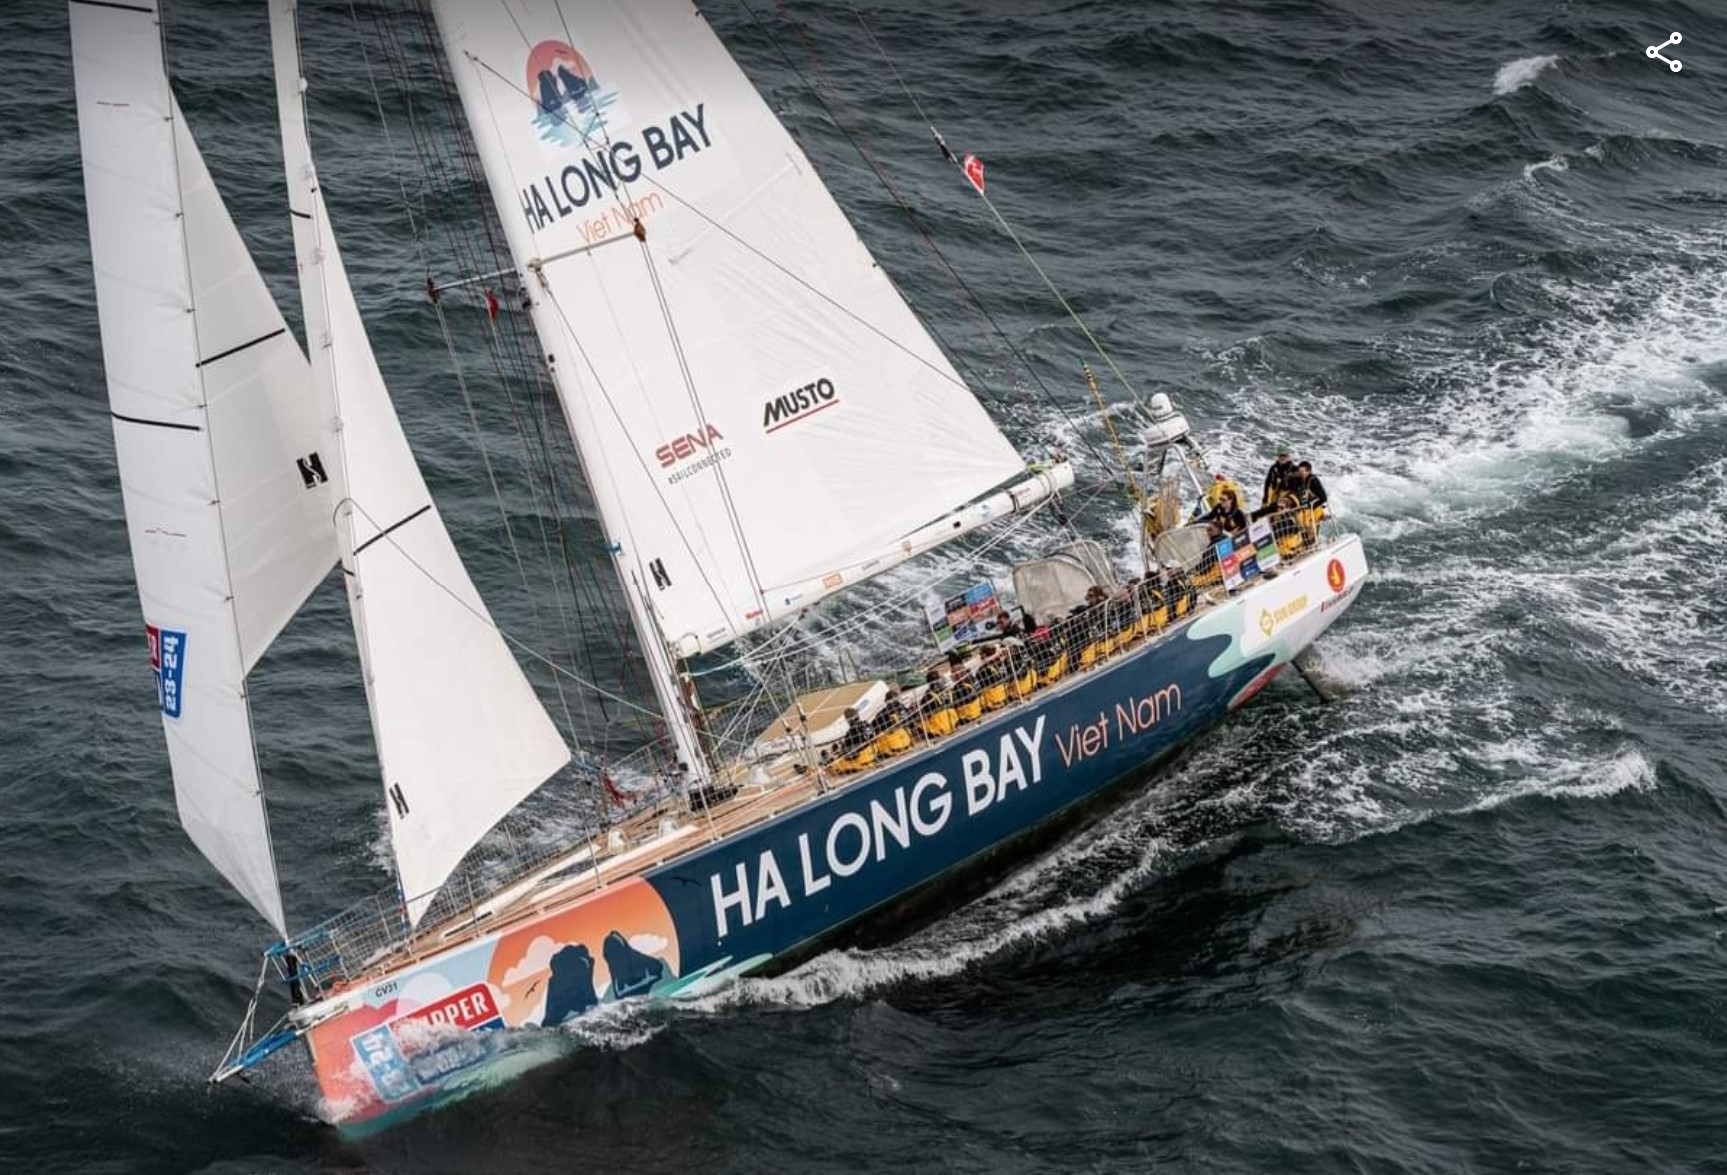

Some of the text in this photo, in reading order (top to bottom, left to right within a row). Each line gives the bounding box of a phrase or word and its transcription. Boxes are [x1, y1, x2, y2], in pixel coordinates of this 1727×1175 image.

[522, 103, 712, 235] HA LONG BAY
[576, 191, 665, 243] Viet Nam
[763, 377, 835, 427] MUSTO
[655, 423, 724, 468] SENA
[163, 635, 179, 711] 23-24
[1054, 683, 1182, 769] Viet Nam
[711, 715, 1047, 938] HA LONG BAY
[374, 982, 399, 998] CV31
